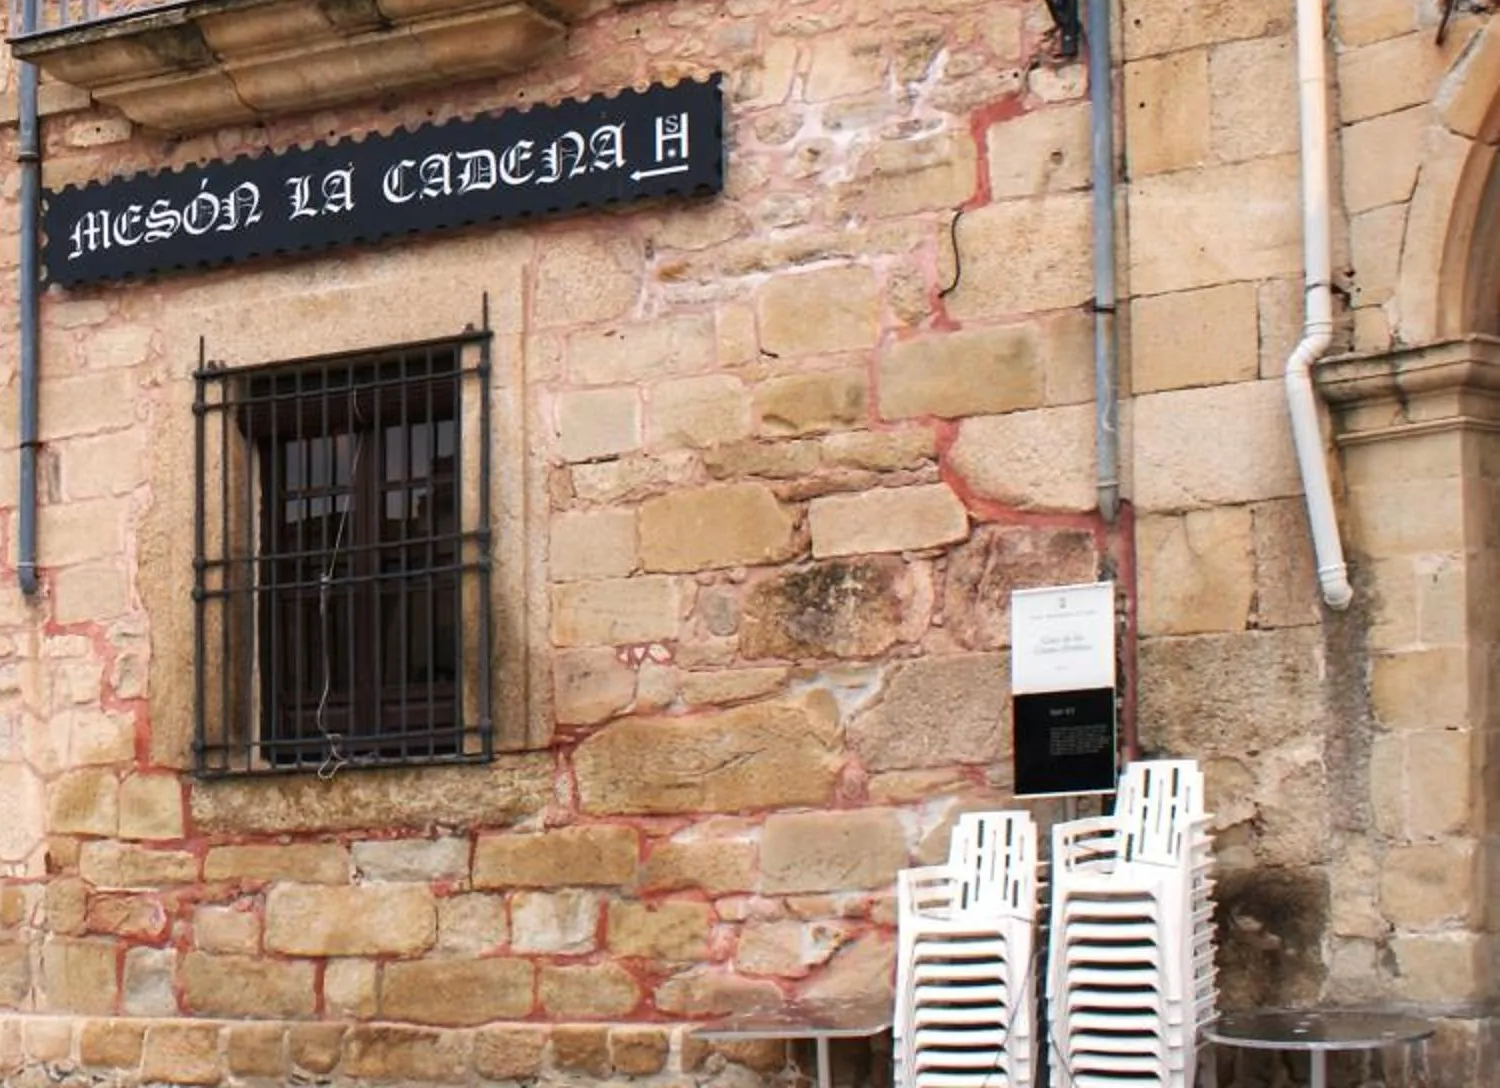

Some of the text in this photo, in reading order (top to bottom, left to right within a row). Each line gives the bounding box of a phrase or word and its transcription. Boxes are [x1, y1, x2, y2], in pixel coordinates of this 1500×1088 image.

[67, 121, 627, 260] MESÓN LA CADENA
